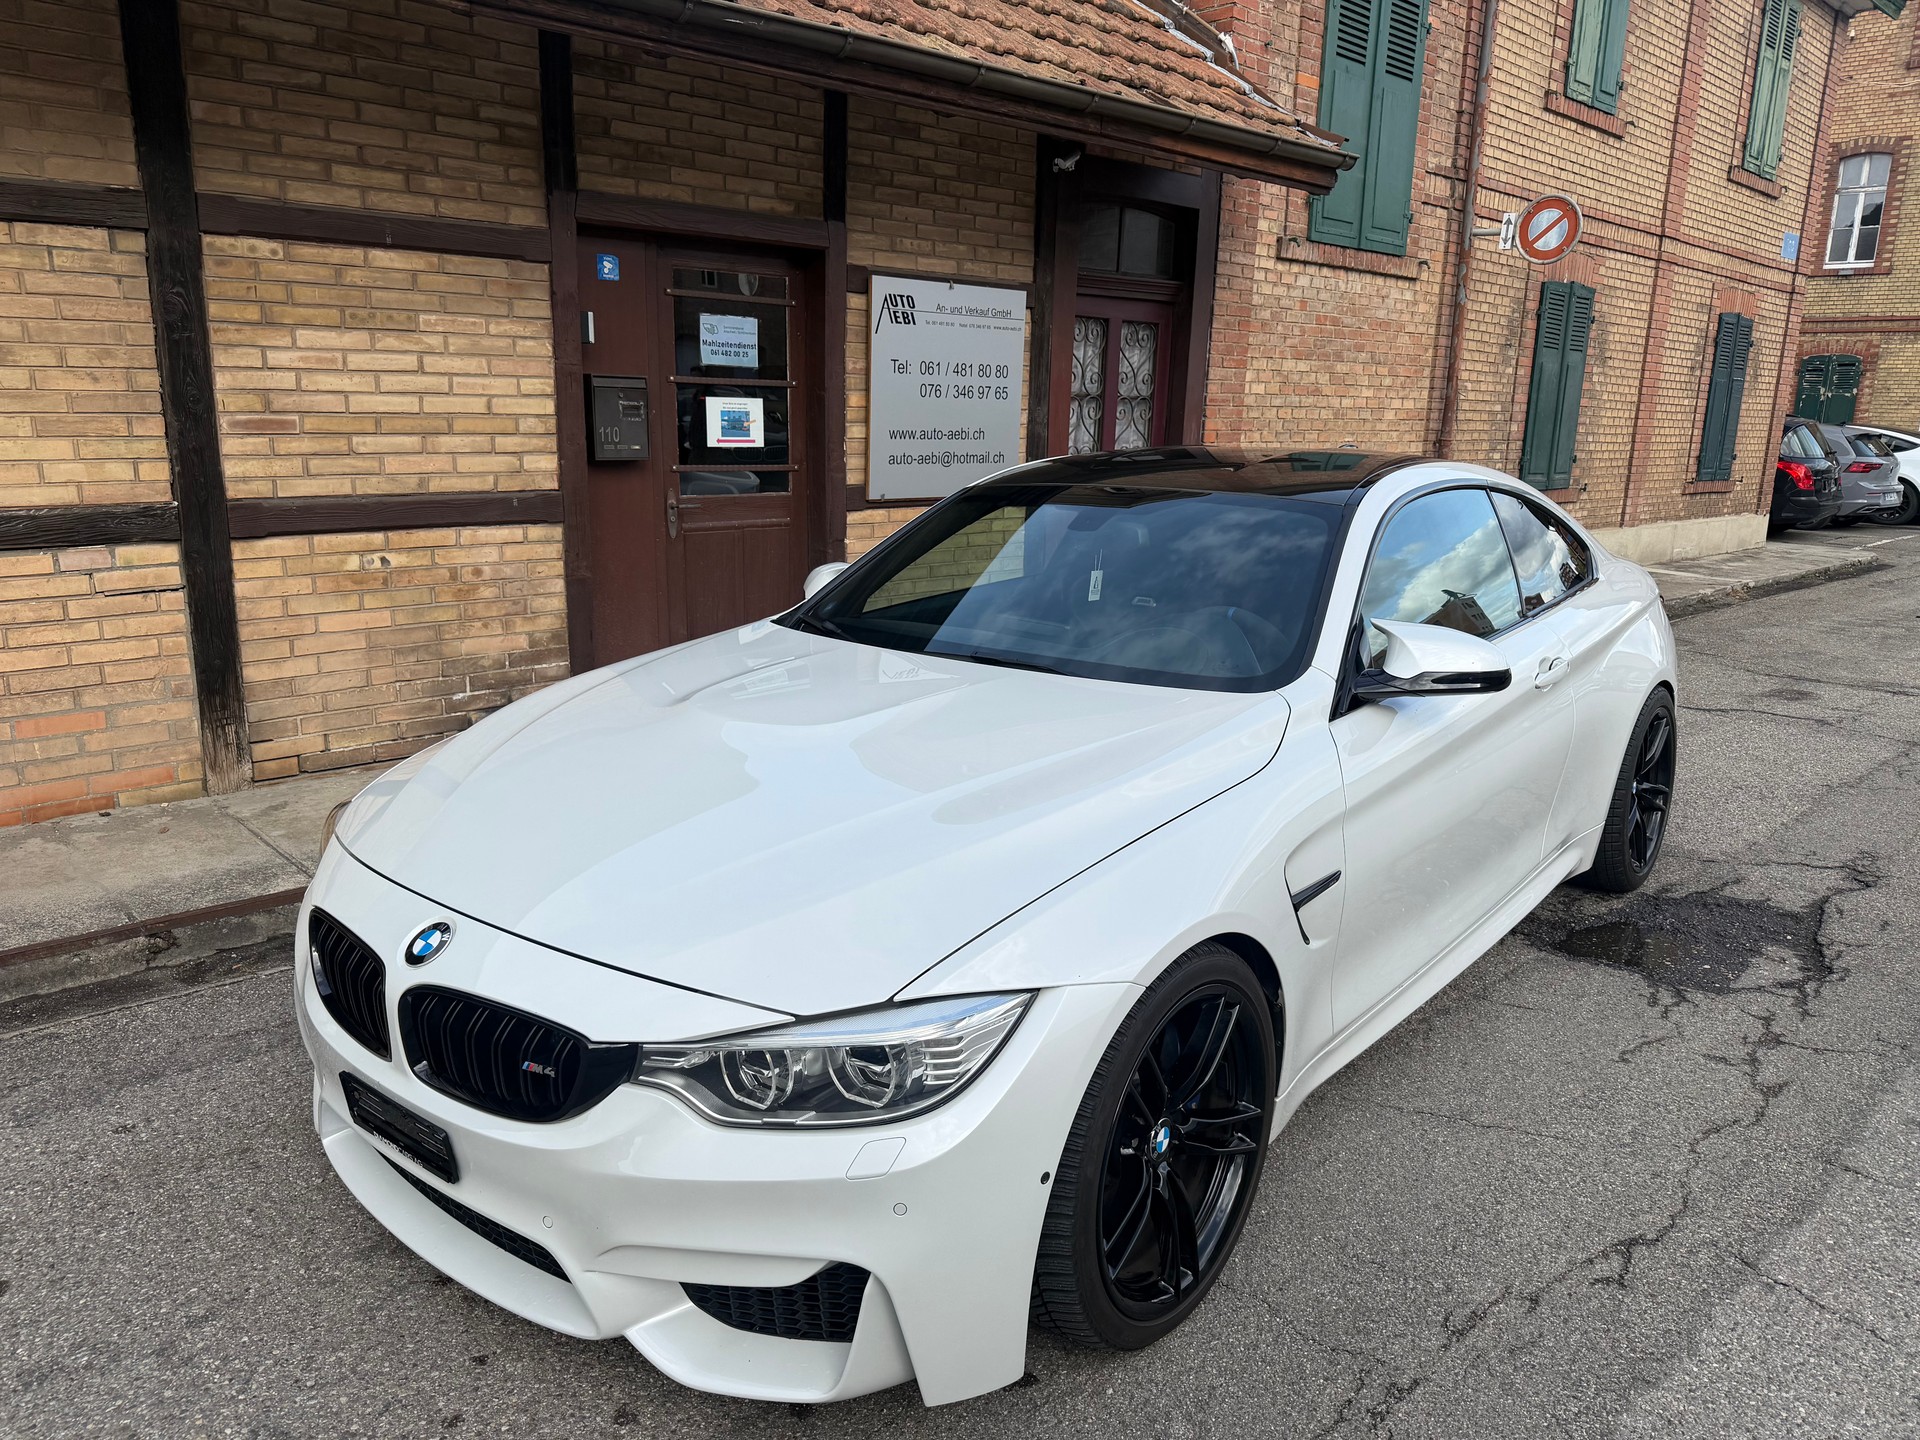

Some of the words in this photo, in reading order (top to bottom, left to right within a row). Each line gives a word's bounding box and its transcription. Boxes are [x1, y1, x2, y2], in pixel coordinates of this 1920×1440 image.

[936, 303, 948, 312] An-
[950, 305, 963, 314] und
[964, 306, 990, 316] Verkauf
[991, 308, 1012, 318] GmbH
[702, 339, 757, 350] Mahlzeitendienst
[890, 359, 912, 375] Tel:
[919, 360, 941, 376] 061
[945, 362, 950, 376] /
[952, 362, 973, 377] 481
[978, 363, 992, 378] 80
[995, 364, 1009, 379] 80
[919, 383, 942, 398] 076
[945, 384, 950, 398] /
[952, 384, 974, 399] 346
[977, 385, 992, 400] 97
[994, 386, 1009, 400] 65
[599, 426, 620, 442] 110
[888, 427, 985, 440] www.auto-aebi.ch
[888, 451, 1005, 468] auto-aebi@hotmail.ch
